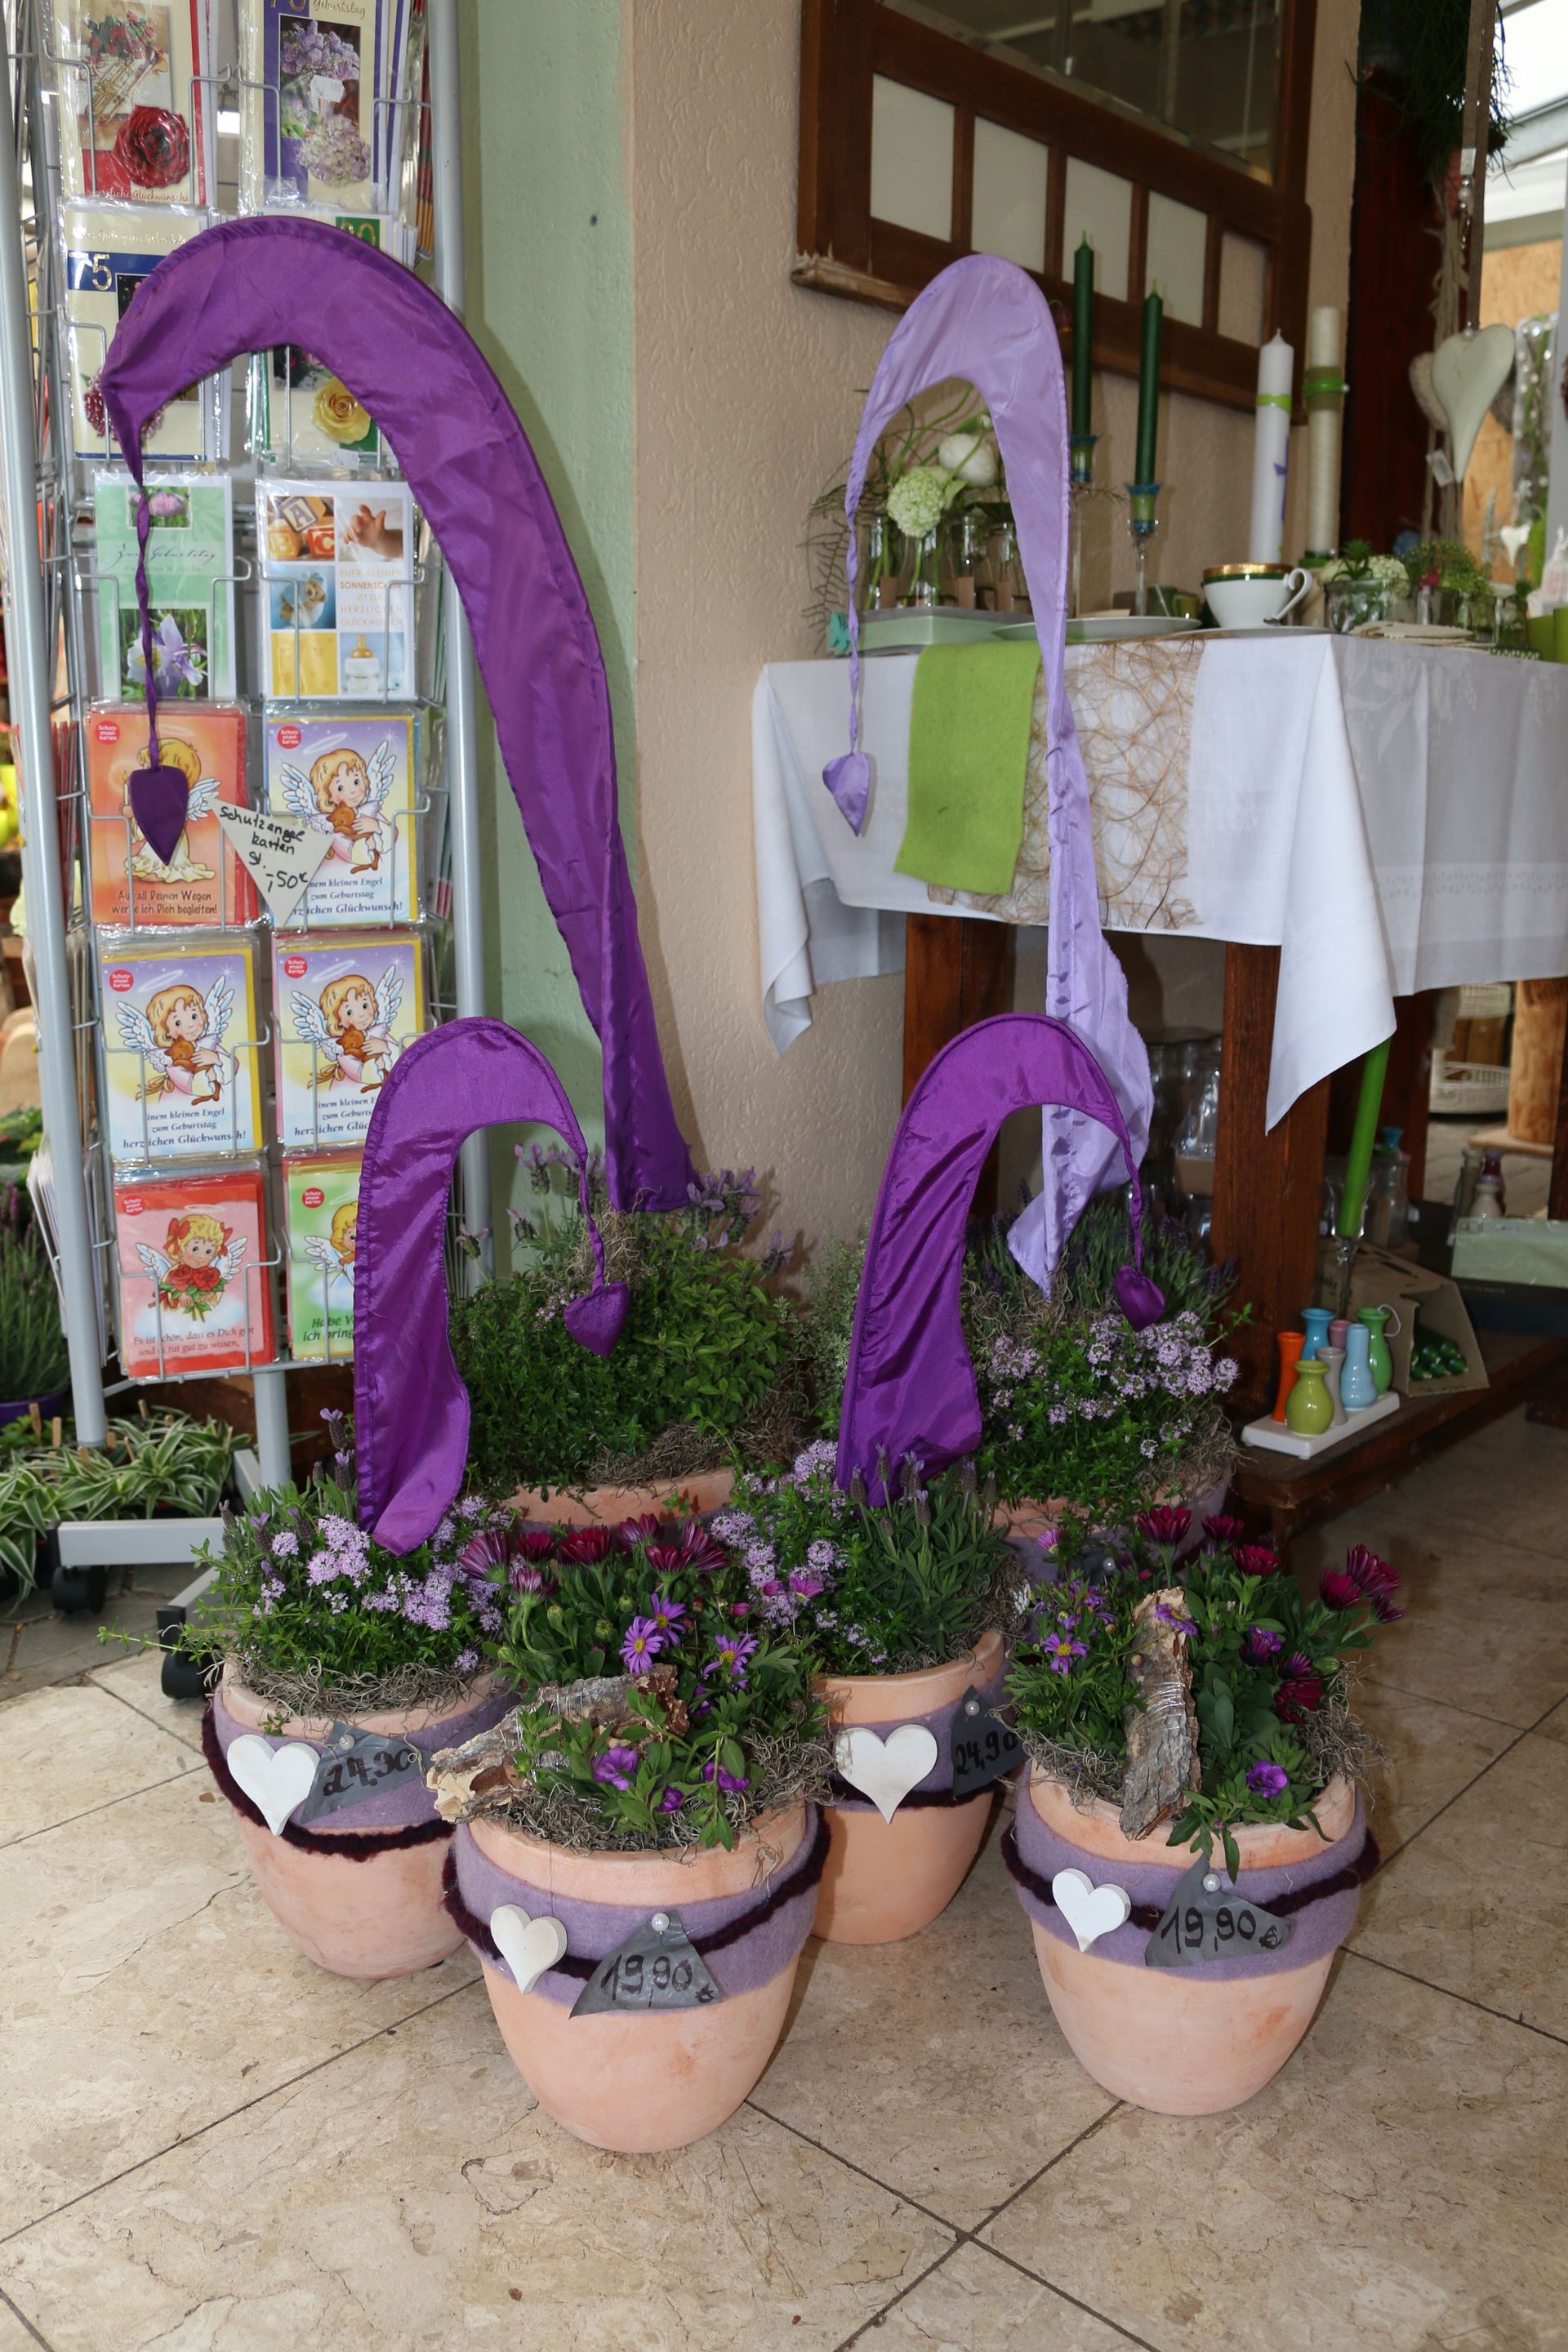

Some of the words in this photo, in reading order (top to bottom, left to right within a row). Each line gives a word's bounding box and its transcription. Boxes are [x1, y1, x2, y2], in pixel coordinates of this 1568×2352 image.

[69, 252, 112, 291] 75
[340, 604, 403, 613] HERZLICEN
[252, 831, 295, 855] karten
[328, 879, 358, 887] kleinen
[360, 877, 383, 888] Engel
[137, 890, 147, 900] all
[150, 890, 178, 900] Deinen
[181, 890, 212, 902] Wegen
[330, 891, 374, 900] Geburtstag
[111, 904, 139, 914] were
[141, 903, 154, 914] ich
[157, 904, 175, 914] Dich
[177, 903, 217, 915] begleiten!
[339, 1098, 368, 1107] kleinen
[169, 1109, 199, 1120] kleinen
[202, 1107, 225, 1118] Engel
[171, 1121, 217, 1131] Geburtstag
[134, 1337, 144, 1345] Es
[146, 1335, 156, 1343] ist
[186, 1331, 204, 1340] dass
[218, 1328, 237, 1338] Dich
[139, 1346, 156, 1356] und
[168, 1344, 180, 1352] tut
[182, 1343, 196, 1353] gut
[211, 1339, 240, 1349] wissen,
